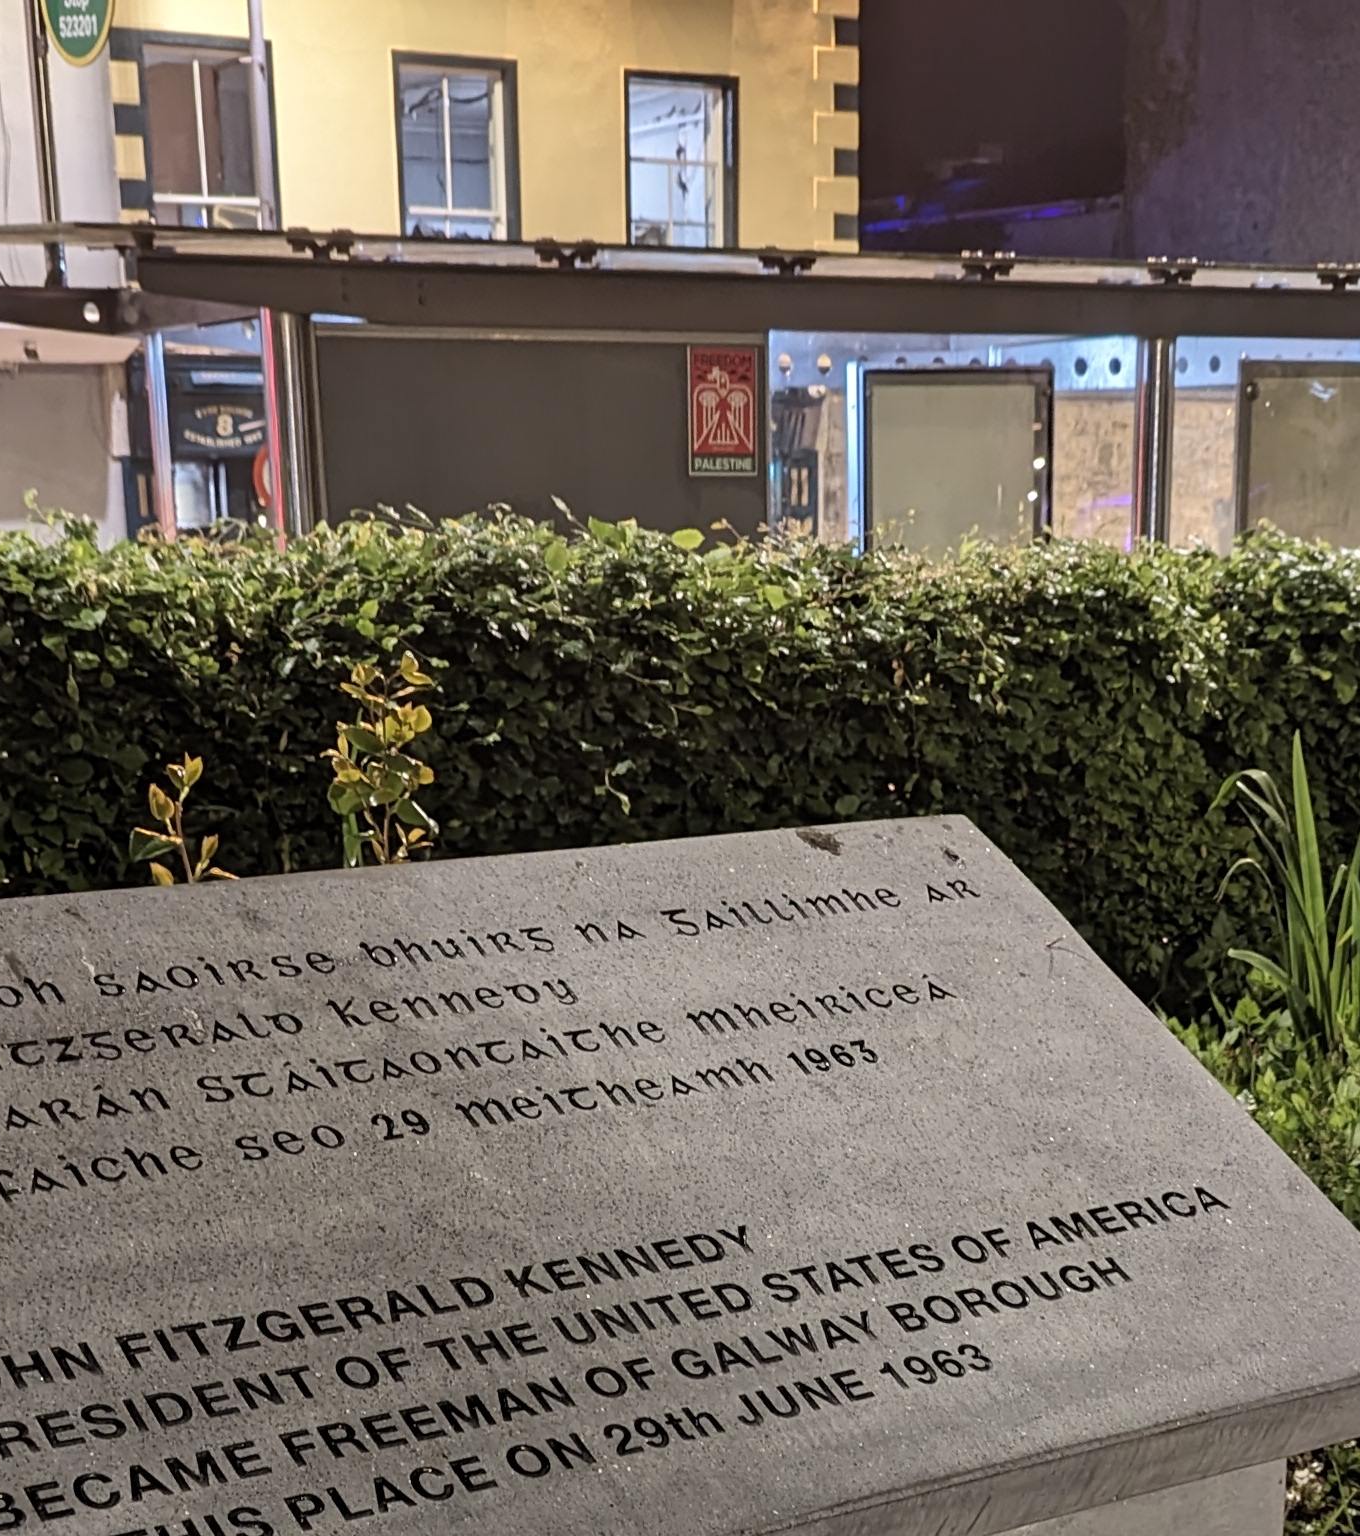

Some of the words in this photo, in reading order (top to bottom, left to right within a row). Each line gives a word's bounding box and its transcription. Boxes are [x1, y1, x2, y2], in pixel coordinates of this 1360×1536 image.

[59, 14, 98, 38] 523201
[693, 353, 752, 366] FREEDOM
[216, 414, 233, 437] 8
[694, 457, 753, 471] PALESTINE
[370, 1109, 431, 1141] 29
[786, 1039, 879, 1077] 1963
[119, 1275, 495, 1369] FITZGERALD
[504, 1224, 757, 1298] KENNEDY
[335, 1347, 415, 1390] OF
[423, 1321, 549, 1371] THE
[558, 1281, 754, 1347] UNITED
[761, 1243, 946, 1304] STATES
[951, 1229, 1012, 1265] OF
[1026, 1185, 1232, 1252] AMERICA
[279, 1376, 578, 1469] FREEMAN
[584, 1355, 659, 1399] OF
[671, 1309, 877, 1379] GALWAY
[886, 1256, 1133, 1333] BOROUGH
[284, 1456, 498, 1532] PLACE
[506, 1432, 597, 1478] ON
[603, 1406, 726, 1456] 29th
[737, 1368, 875, 1427] JUNE
[879, 1342, 994, 1390] 1963
